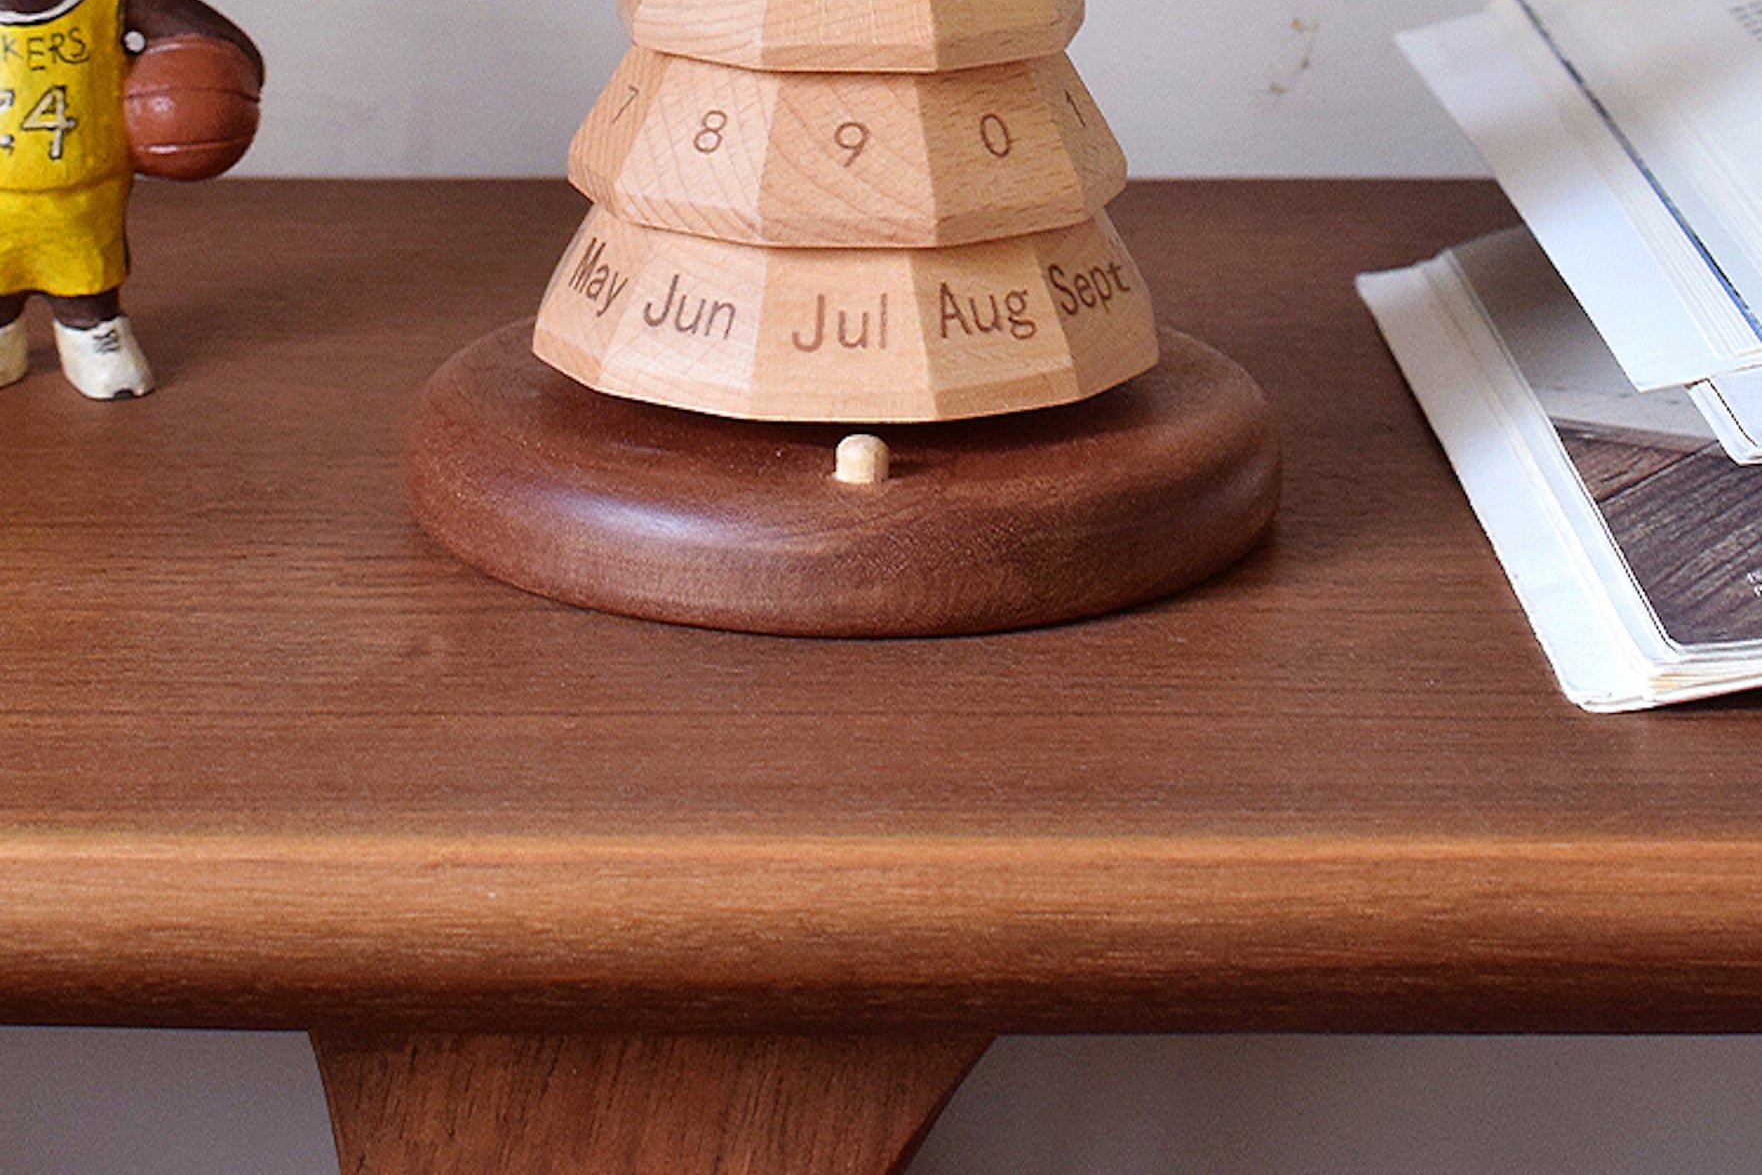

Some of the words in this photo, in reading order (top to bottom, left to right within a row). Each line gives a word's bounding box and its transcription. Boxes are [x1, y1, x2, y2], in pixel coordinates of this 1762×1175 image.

[612, 85, 639, 125] 7
[692, 109, 728, 154] 8
[833, 121, 871, 168] 9
[979, 112, 1013, 159] 0
[1063, 88, 1087, 128] 1
[568, 237, 629, 317] May
[643, 274, 737, 340] Jun
[791, 292, 889, 353] Jul
[938, 281, 1038, 340] Aug
[1048, 261, 1131, 315] Sept
